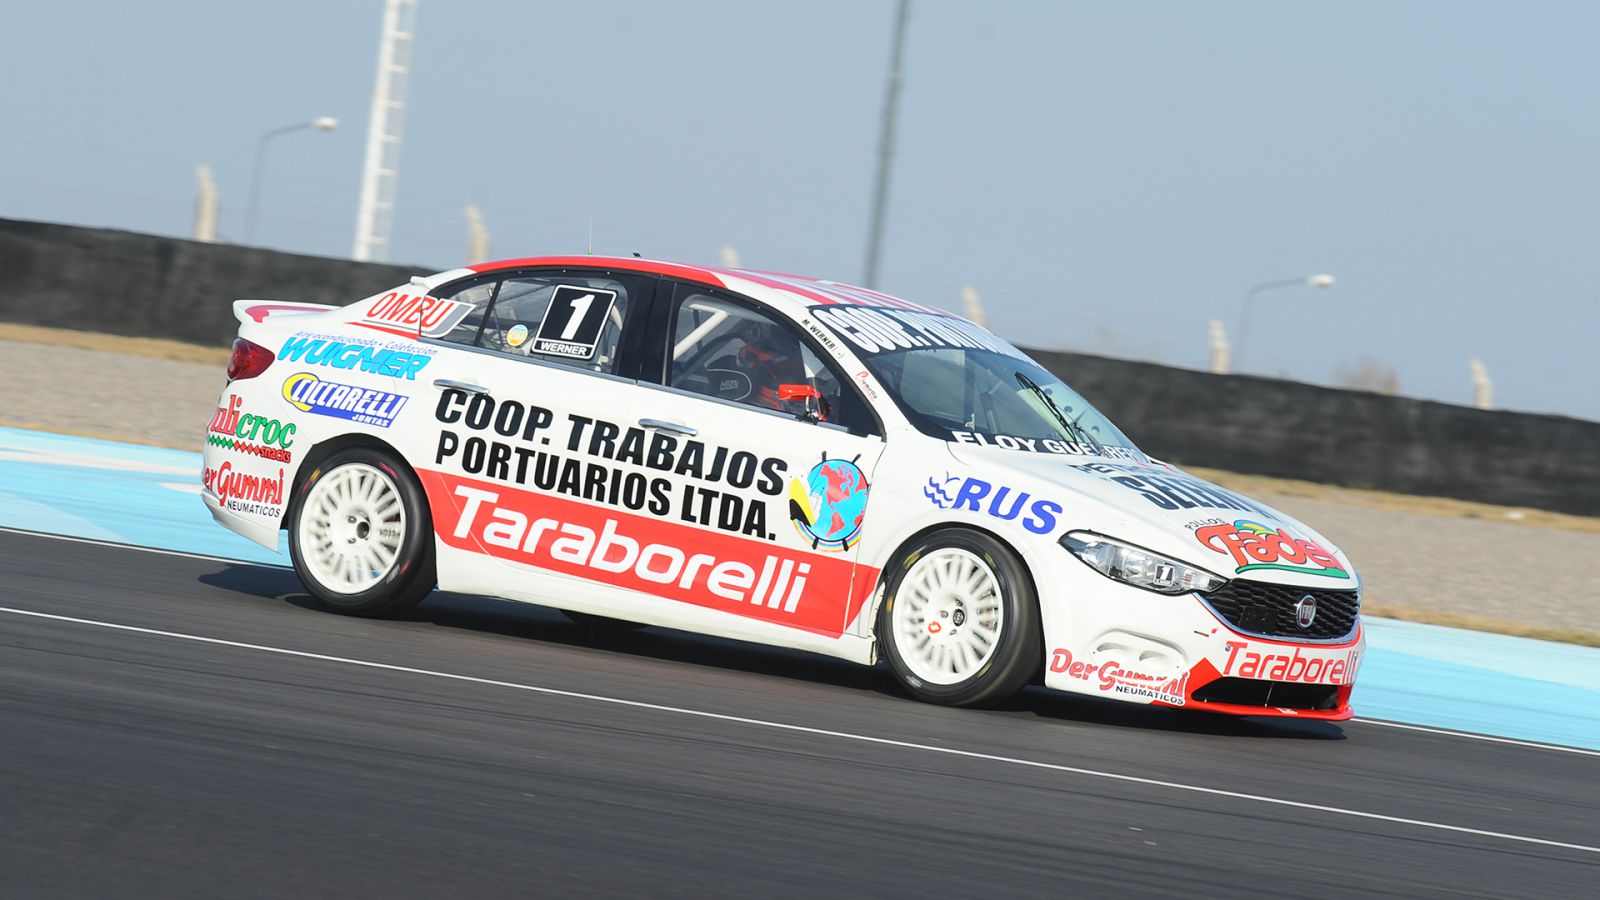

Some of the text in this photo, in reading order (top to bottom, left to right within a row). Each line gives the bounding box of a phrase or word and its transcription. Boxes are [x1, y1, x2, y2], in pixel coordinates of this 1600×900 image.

[367, 292, 455, 328] OMBU
[561, 294, 596, 340] 1
[540, 341, 588, 356] WERNER
[810, 325, 836, 350] WERNER
[291, 379, 406, 419] CICCARELLI
[351, 414, 390, 427] JUNTAS
[260, 446, 291, 464] snacks
[435, 388, 788, 497] COOP. TRABAJOS
[951, 430, 1038, 452] ELOY
[435, 430, 777, 541] PORTUARIOS LTDA.
[227, 499, 281, 518] NEUMATICOS
[951, 476, 1063, 535] RUS
[1184, 517, 1228, 531] POLLOS
[452, 484, 812, 614] Taraborelli
[1222, 640, 1358, 685] Taraborelli
[1115, 685, 1184, 705] NEUMATICOS
